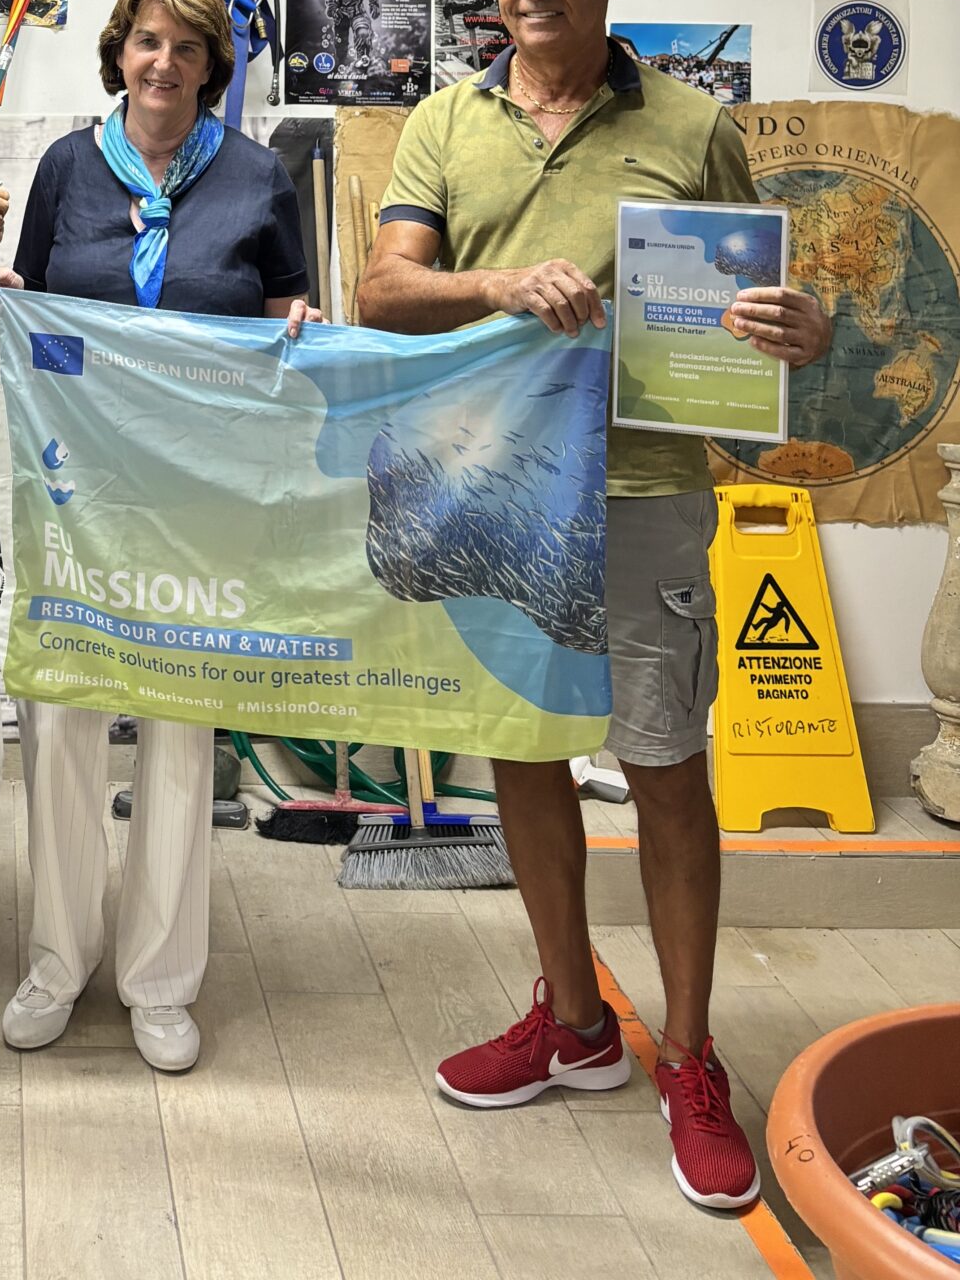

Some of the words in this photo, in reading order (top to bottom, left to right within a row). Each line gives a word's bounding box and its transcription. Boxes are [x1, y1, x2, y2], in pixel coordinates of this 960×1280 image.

[826, 6, 872, 33] SOMMOZZATORI
[875, 10, 899, 46] VOLONTARI
[821, 33, 839, 75] GONDOLIERI
[880, 48, 899, 75] VENEZIA
[815, 143, 919, 192] ORIENTALE
[647, 274, 664, 285] EU
[647, 285, 730, 304] MISSIONS
[647, 305, 683, 315] RESTORE
[685, 307, 703, 315] OUR
[647, 313, 676, 322] OCEAN
[684, 316, 717, 325] WATERS
[647, 324, 677, 333] Mission
[678, 326, 706, 335] Charter
[91, 350, 182, 378] EUROPEAN
[185, 367, 245, 386] UNION
[669, 351, 720, 362] Associazione
[720, 355, 762, 366] Gondolieri
[669, 361, 725, 372] Sommozzatori
[726, 365, 764, 376] Volontari
[764, 368, 773, 376] di
[669, 371, 699, 380] Venezia
[878, 374, 927, 392] AUSTRALIA
[45, 521, 73, 556] EU
[44, 552, 246, 619] MISSIONS
[41, 601, 114, 632] RESTORE
[120, 624, 157, 642] OUR
[164, 629, 231, 650] OCEAN
[239, 635, 252, 651] &
[259, 638, 339, 657] WATERS
[39, 631, 115, 659] Concrete
[119, 645, 196, 679] solutions
[202, 661, 227, 681] for
[233, 668, 265, 685] our
[271, 666, 350, 689] greatest
[356, 667, 461, 695] challenges
[738, 656, 822, 670] ATTENZIONE
[750, 674, 812, 685] PAVIMENTO
[35, 668, 129, 691] #EUmissions
[138, 685, 224, 710] #HorizonEU
[237, 700, 358, 717] #MissionOcean
[757, 689, 809, 700] BAGNATO
